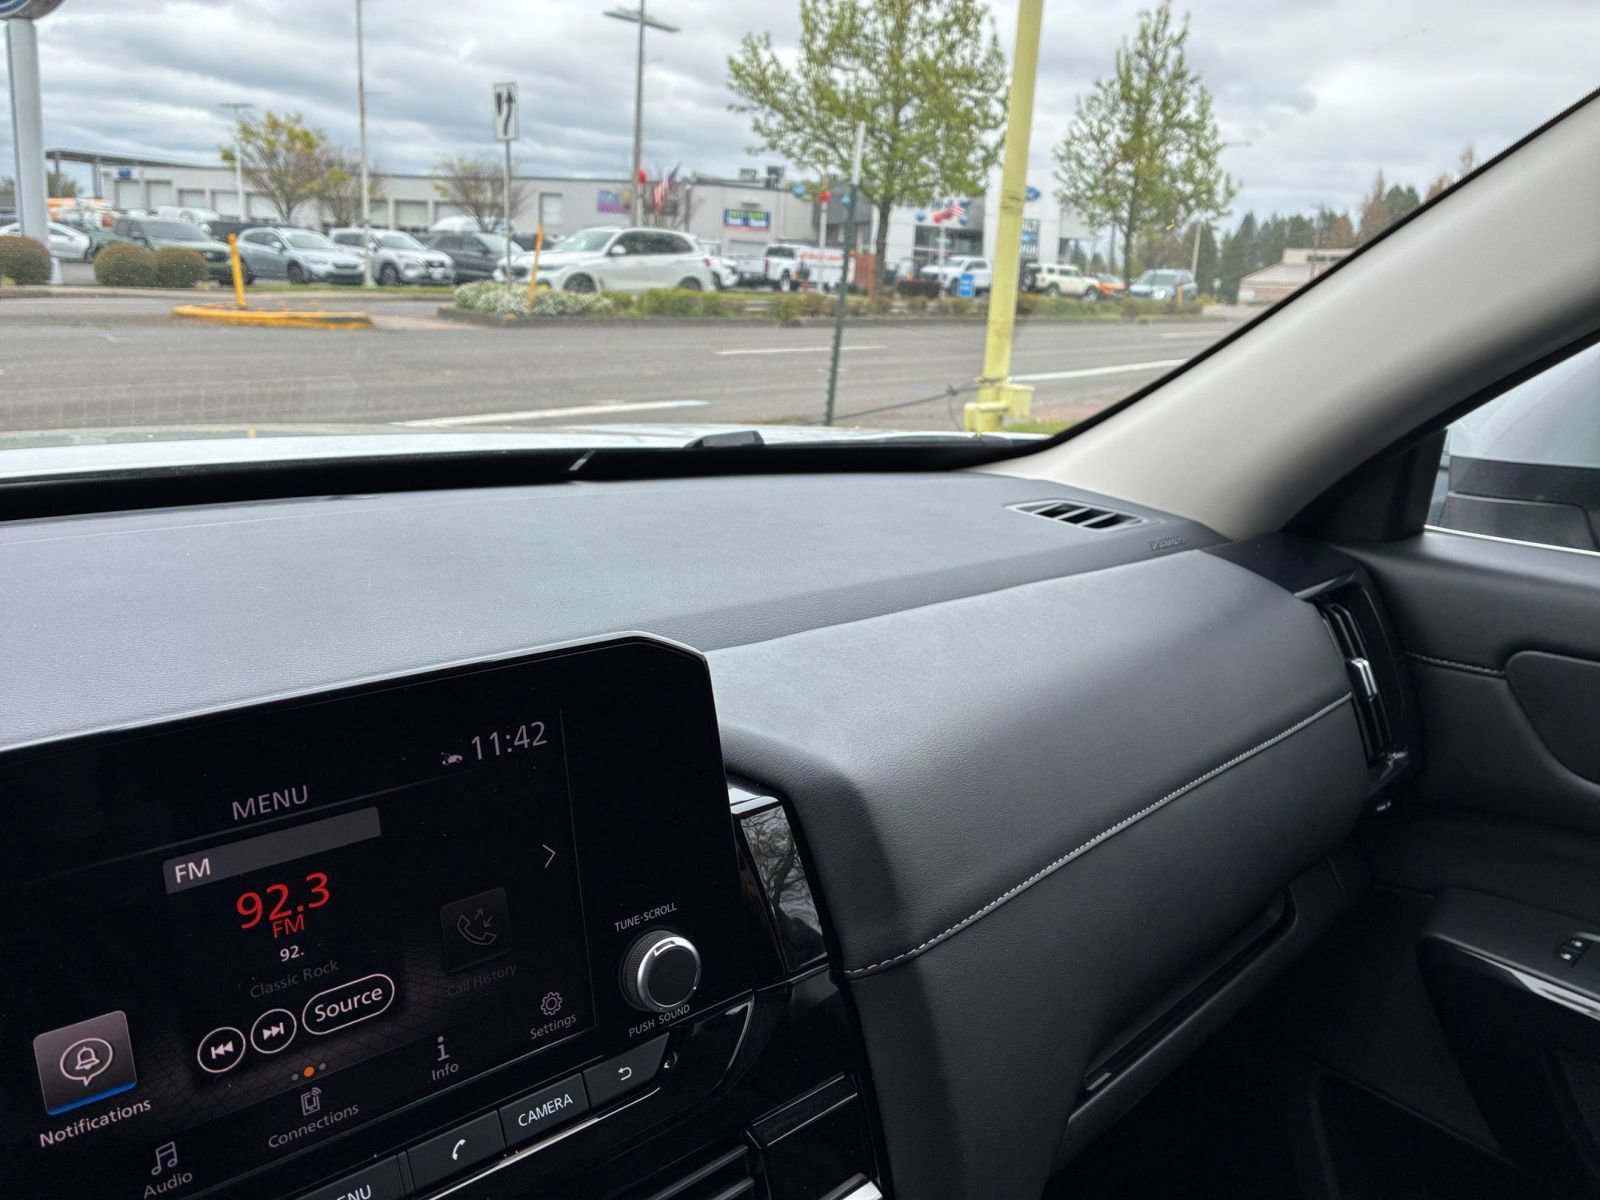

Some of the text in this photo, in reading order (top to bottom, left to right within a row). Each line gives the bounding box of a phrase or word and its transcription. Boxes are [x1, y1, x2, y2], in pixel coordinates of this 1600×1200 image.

[471, 720, 548, 761] 11:42
[231, 785, 309, 821] MENU
[174, 858, 211, 883] FM
[236, 872, 331, 929] 92.3
[272, 916, 305, 939] FM
[279, 945, 305, 962] 92.
[249, 960, 339, 999] Classic Rock
[448, 964, 517, 997] Call History
[314, 988, 383, 1022] Source
[628, 1004, 690, 1038] PUSH SOUND
[529, 1014, 577, 1040] Settings
[431, 1062, 459, 1080] Info
[40, 1097, 151, 1148] Notifications
[268, 1102, 360, 1149] Connections
[518, 1093, 574, 1127] CAMERA
[143, 1173, 193, 1200] Audio
